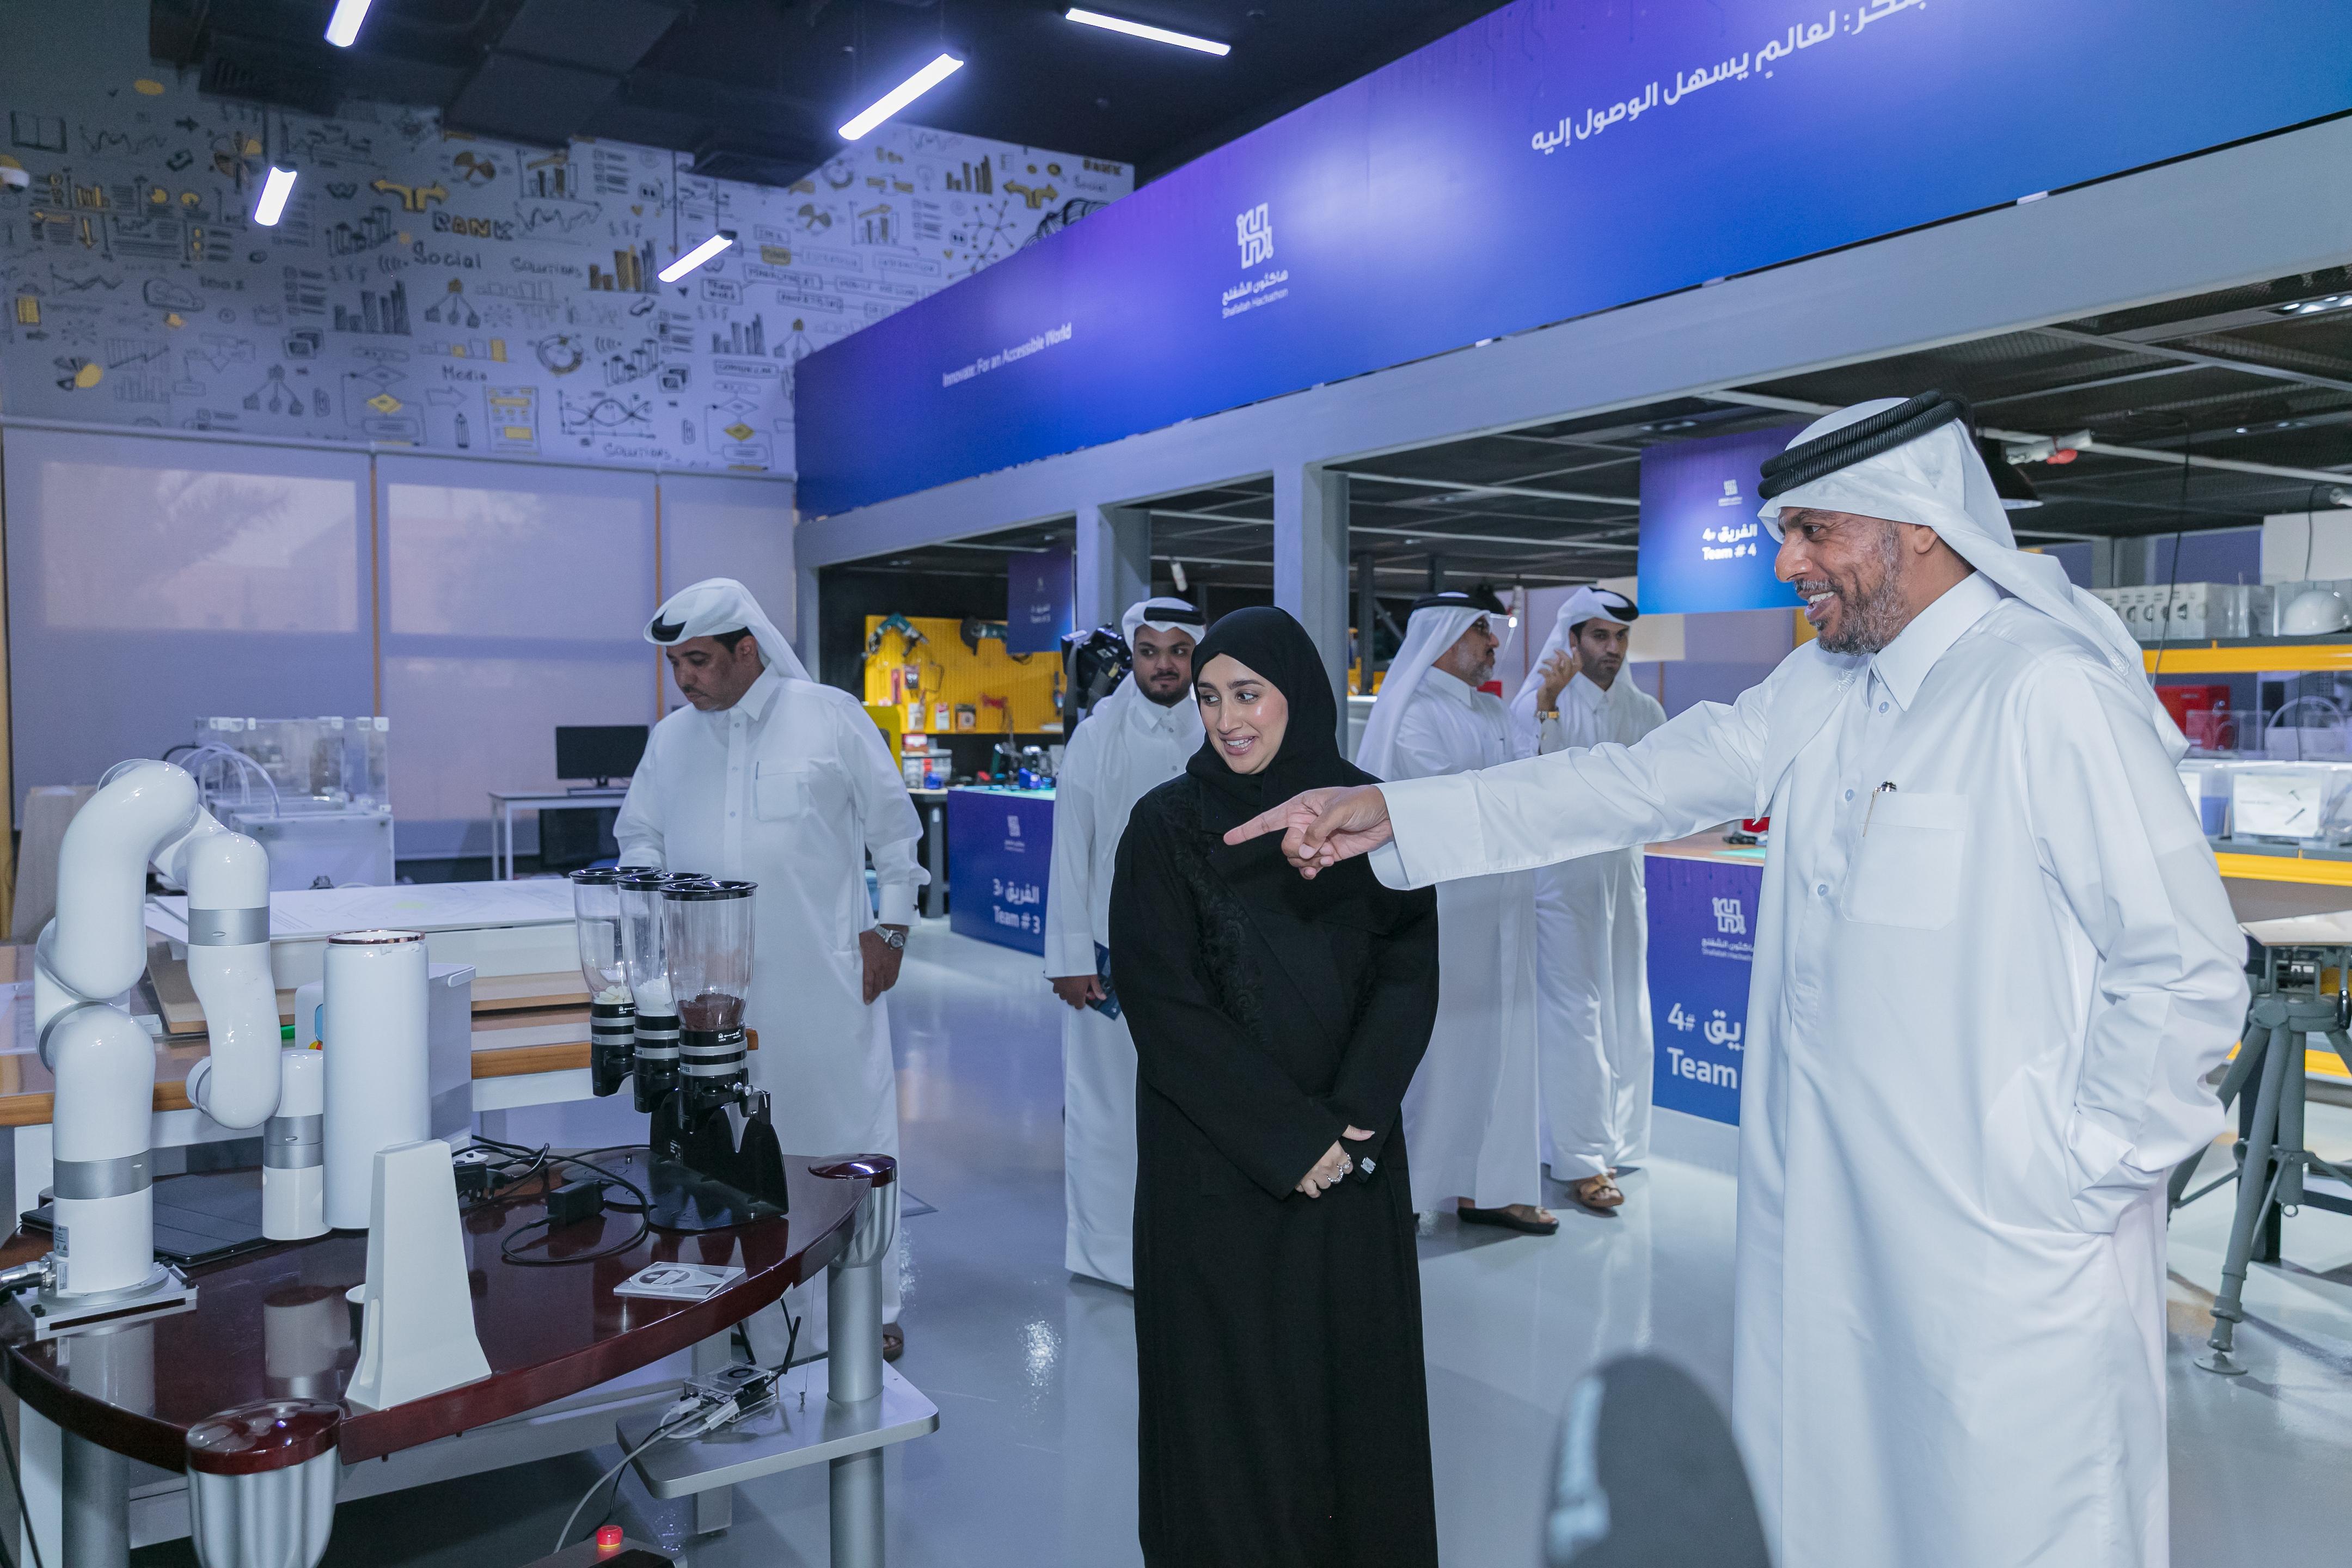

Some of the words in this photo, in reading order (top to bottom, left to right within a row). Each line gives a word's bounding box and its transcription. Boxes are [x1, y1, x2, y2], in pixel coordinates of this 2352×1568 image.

[1663, 51, 1750, 106] يسهل
[1575, 81, 1658, 140] الوصول
[1532, 117, 1571, 156] إليه
[413, 240, 481, 270] Social
[1252, 287, 1289, 308] Hackathon
[1002, 335, 1044, 365] Accessible
[1044, 321, 1072, 347] World
[1718, 523, 1758, 543] الفريق
[1701, 546, 1733, 561] Team
[1747, 542, 1757, 557] 4
[993, 905, 1020, 928] Team
[1032, 915, 1040, 935] 3
[1667, 1046, 1738, 1090] Team
